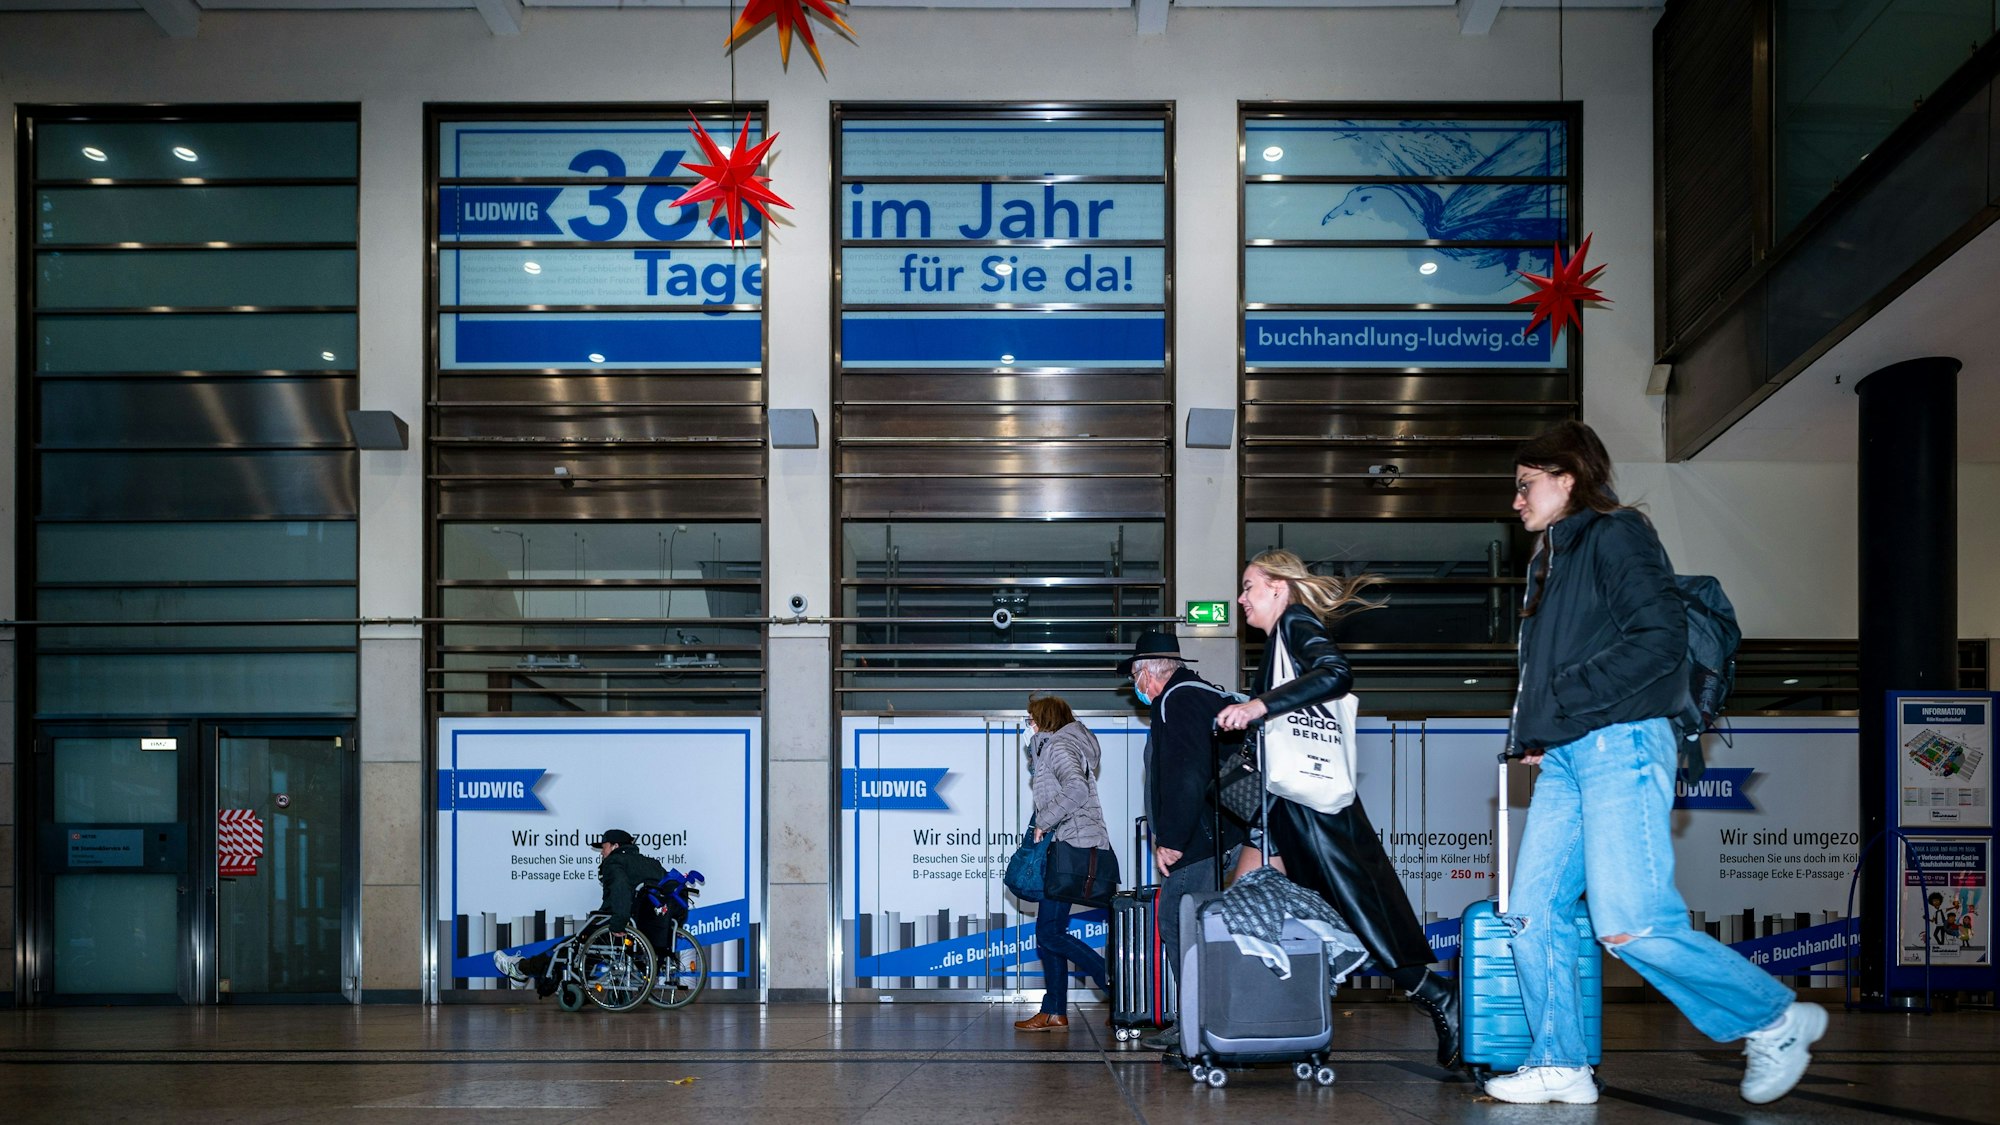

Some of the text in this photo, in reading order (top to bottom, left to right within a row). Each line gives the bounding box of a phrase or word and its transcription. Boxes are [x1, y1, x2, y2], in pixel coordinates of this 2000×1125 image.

[464, 201, 539, 222] LUDWIG
[851, 172, 1114, 239] im Jahr
[899, 253, 1134, 293] für Sie da!
[634, 250, 762, 316] Tage
[1258, 326, 1540, 352] buchhandlung-ludwig.de
[1922, 707, 1967, 716] INFORMATION
[1287, 715, 1343, 735] adidas
[1292, 728, 1342, 745] BERLIN
[458, 781, 525, 799] LUDWIG
[861, 780, 927, 798] LUDWIG
[1674, 780, 1733, 797] UDWIG
[512, 829, 540, 847] Wir
[545, 829, 580, 847] sind
[913, 828, 941, 845] Wir
[946, 828, 981, 845] sind
[1390, 829, 1493, 850] umgezogen!
[1720, 828, 1860, 849] Wir sind umgezo
[511, 854, 557, 865] Besuchen
[560, 854, 574, 865] Sie
[576, 856, 593, 865] uns
[667, 854, 687, 864] Hbf.
[912, 853, 958, 864] Besuchen
[961, 853, 976, 864] Sie
[977, 855, 995, 864] uns
[1427, 854, 1438, 864] im
[1441, 853, 1471, 864] Kölner
[1473, 853, 1493, 864] Hbf.
[1719, 853, 1765, 863] Besuchen
[1767, 853, 1782, 863] Sie
[1803, 853, 1826, 863] doch
[1828, 854, 1840, 863] im
[511, 870, 561, 882] B-Passage
[563, 870, 585, 880] Ecke
[912, 869, 962, 881] B-Passage
[965, 869, 986, 879] Ecke
[1451, 869, 1472, 879] 250
[1719, 869, 1845, 880] B-Passage Ecke E-Passage
[929, 951, 964, 970] ...die
[966, 935, 1038, 963] Buchhandl
